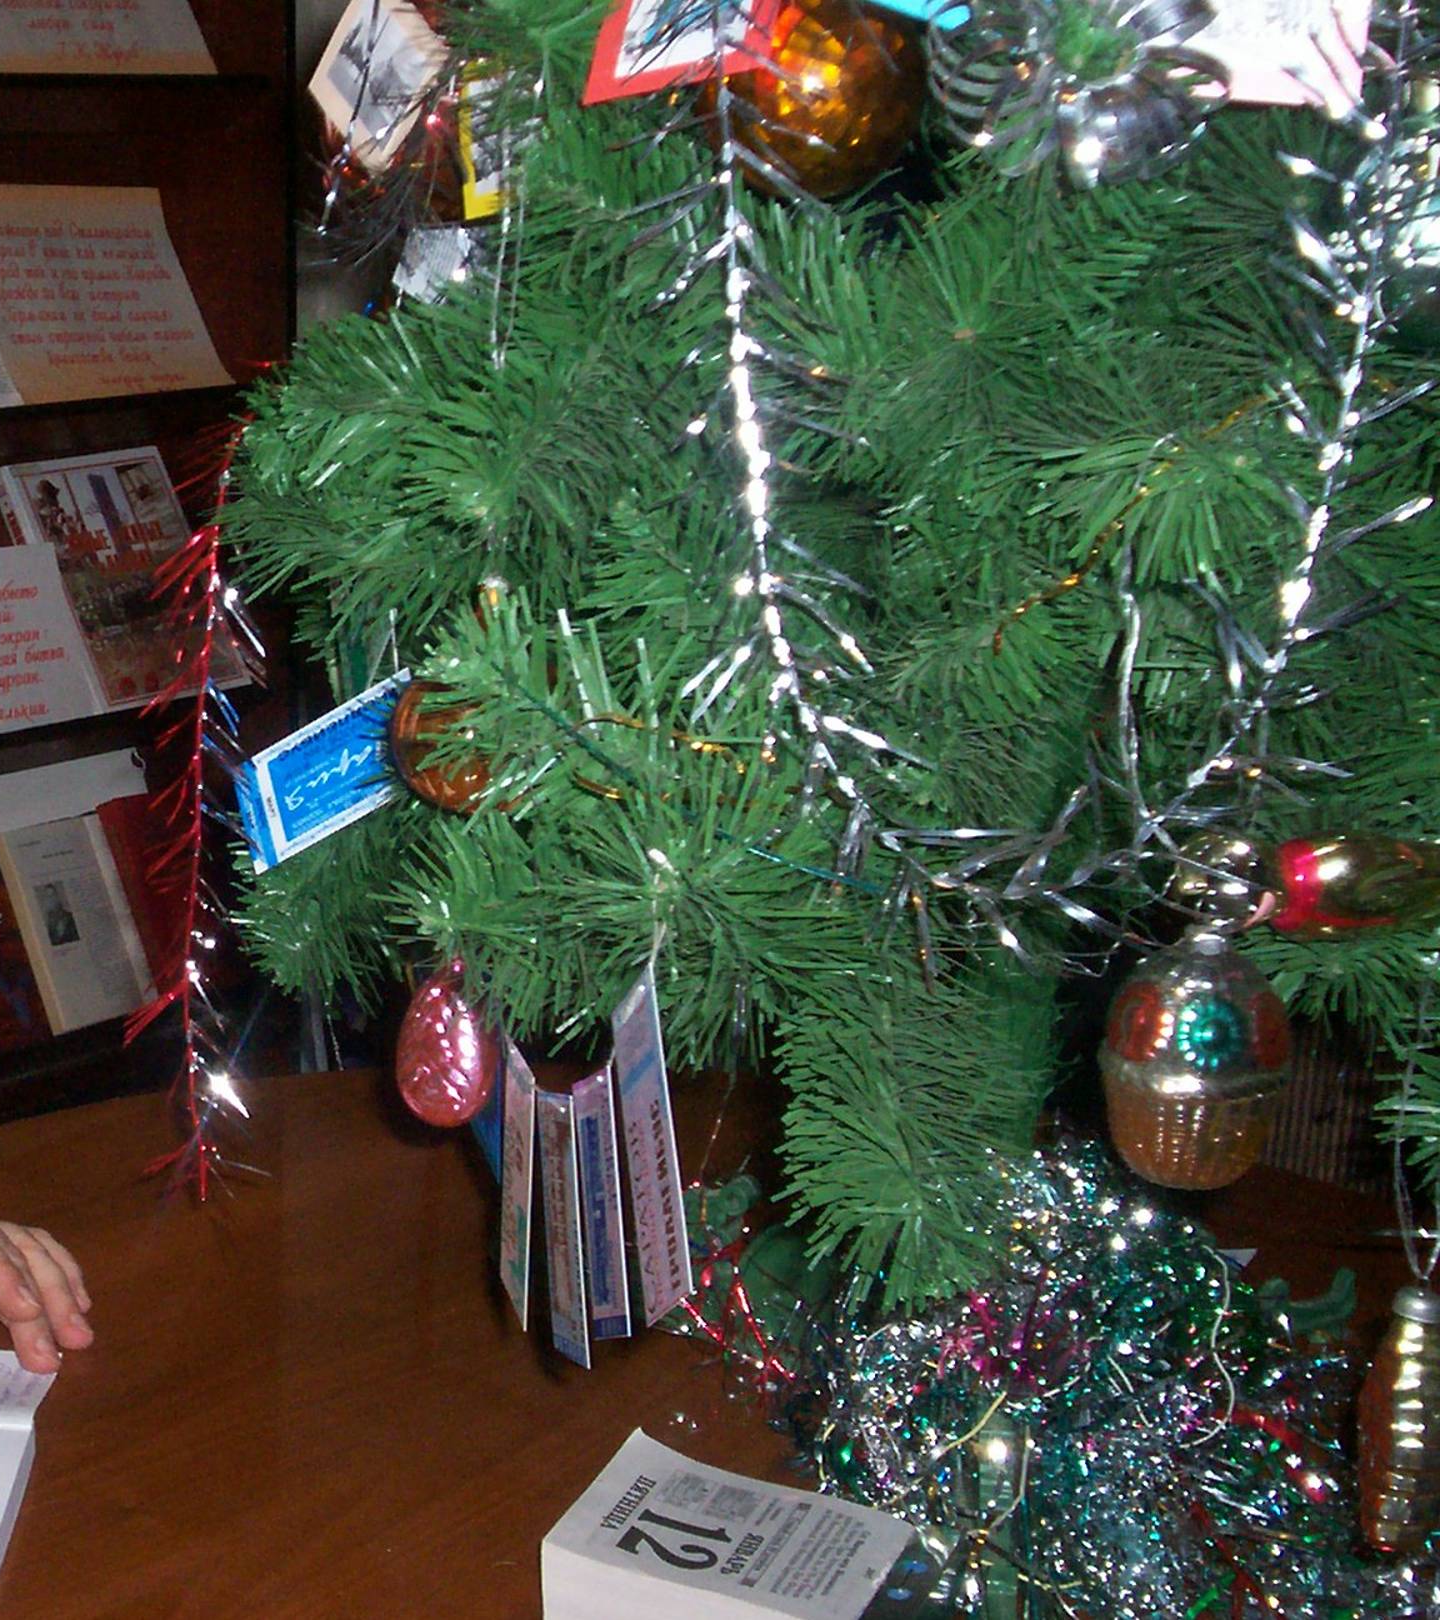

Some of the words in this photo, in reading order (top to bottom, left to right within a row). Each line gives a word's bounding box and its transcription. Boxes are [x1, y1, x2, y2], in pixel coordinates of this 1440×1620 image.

[600, 1474, 657, 1530] ПЯТНИЦА
[615, 1507, 733, 1570] 12
[720, 1531, 765, 1575] ЯНВАРЬ
